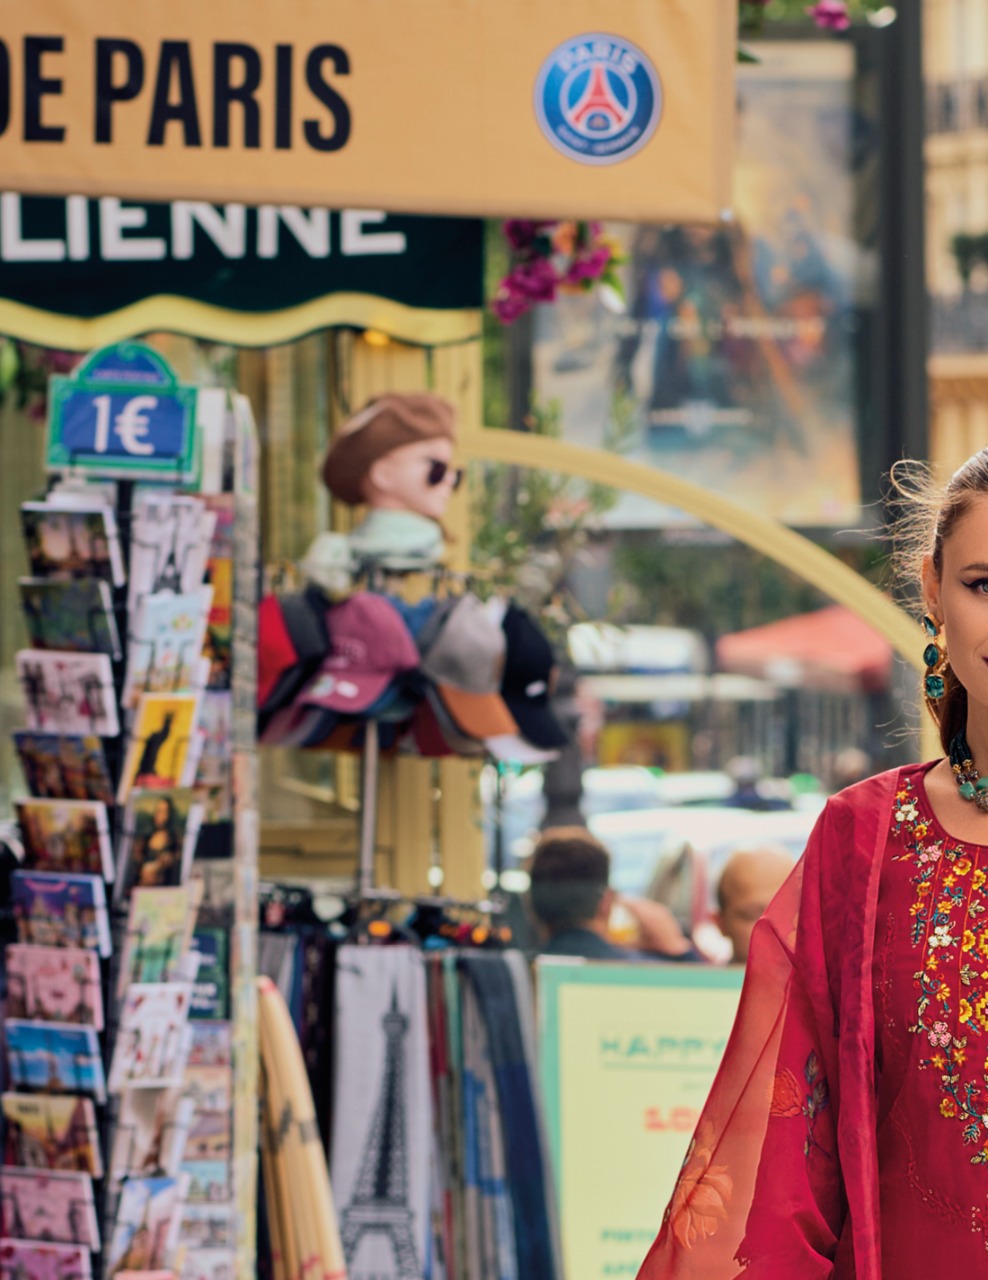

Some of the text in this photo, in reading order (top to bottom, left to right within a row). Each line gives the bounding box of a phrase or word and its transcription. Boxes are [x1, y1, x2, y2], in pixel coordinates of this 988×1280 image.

[556, 41, 638, 75] PARIS
[94, 37, 352, 153] PARIS
[91, 395, 158, 456] 1€
